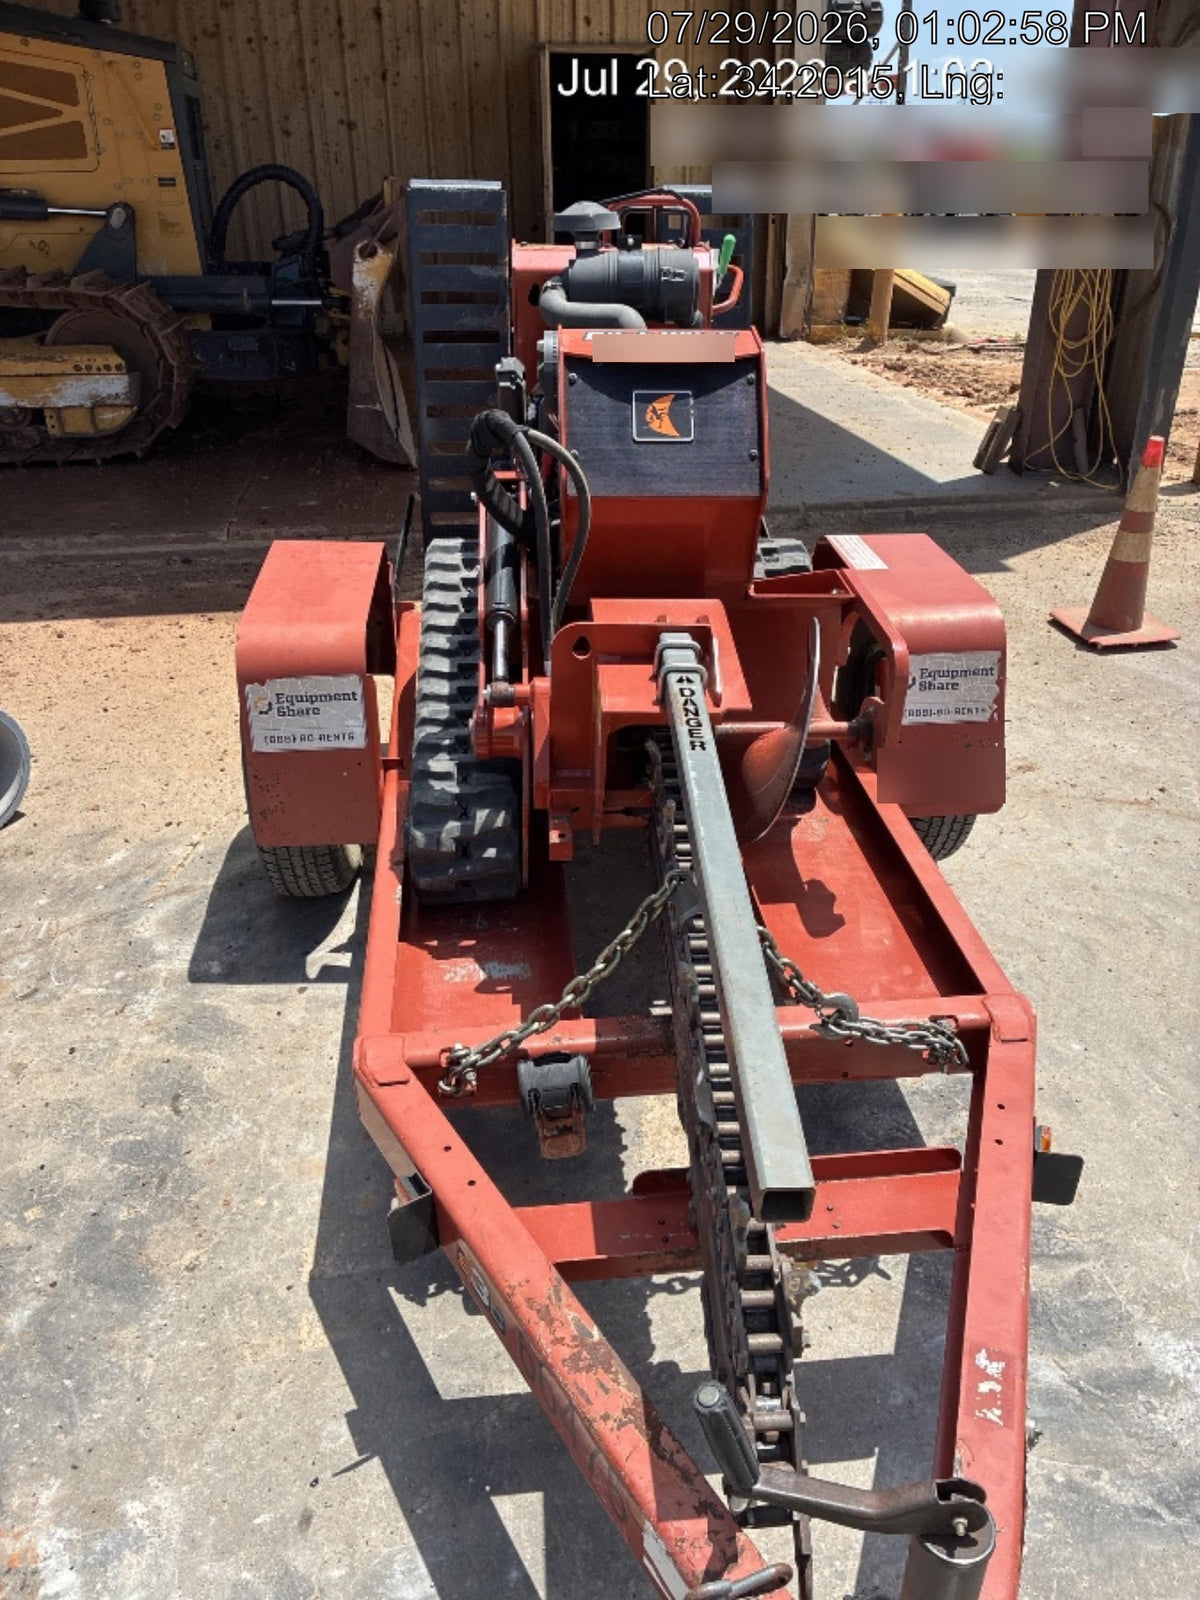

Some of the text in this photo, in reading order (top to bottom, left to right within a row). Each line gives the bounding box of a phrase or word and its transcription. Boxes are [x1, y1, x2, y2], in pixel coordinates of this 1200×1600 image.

[920, 666, 995, 680] Equipment
[919, 680, 960, 692] Share
[275, 690, 358, 706] Equipment
[276, 705, 321, 717] Share
[678, 687, 707, 751] DANGER
